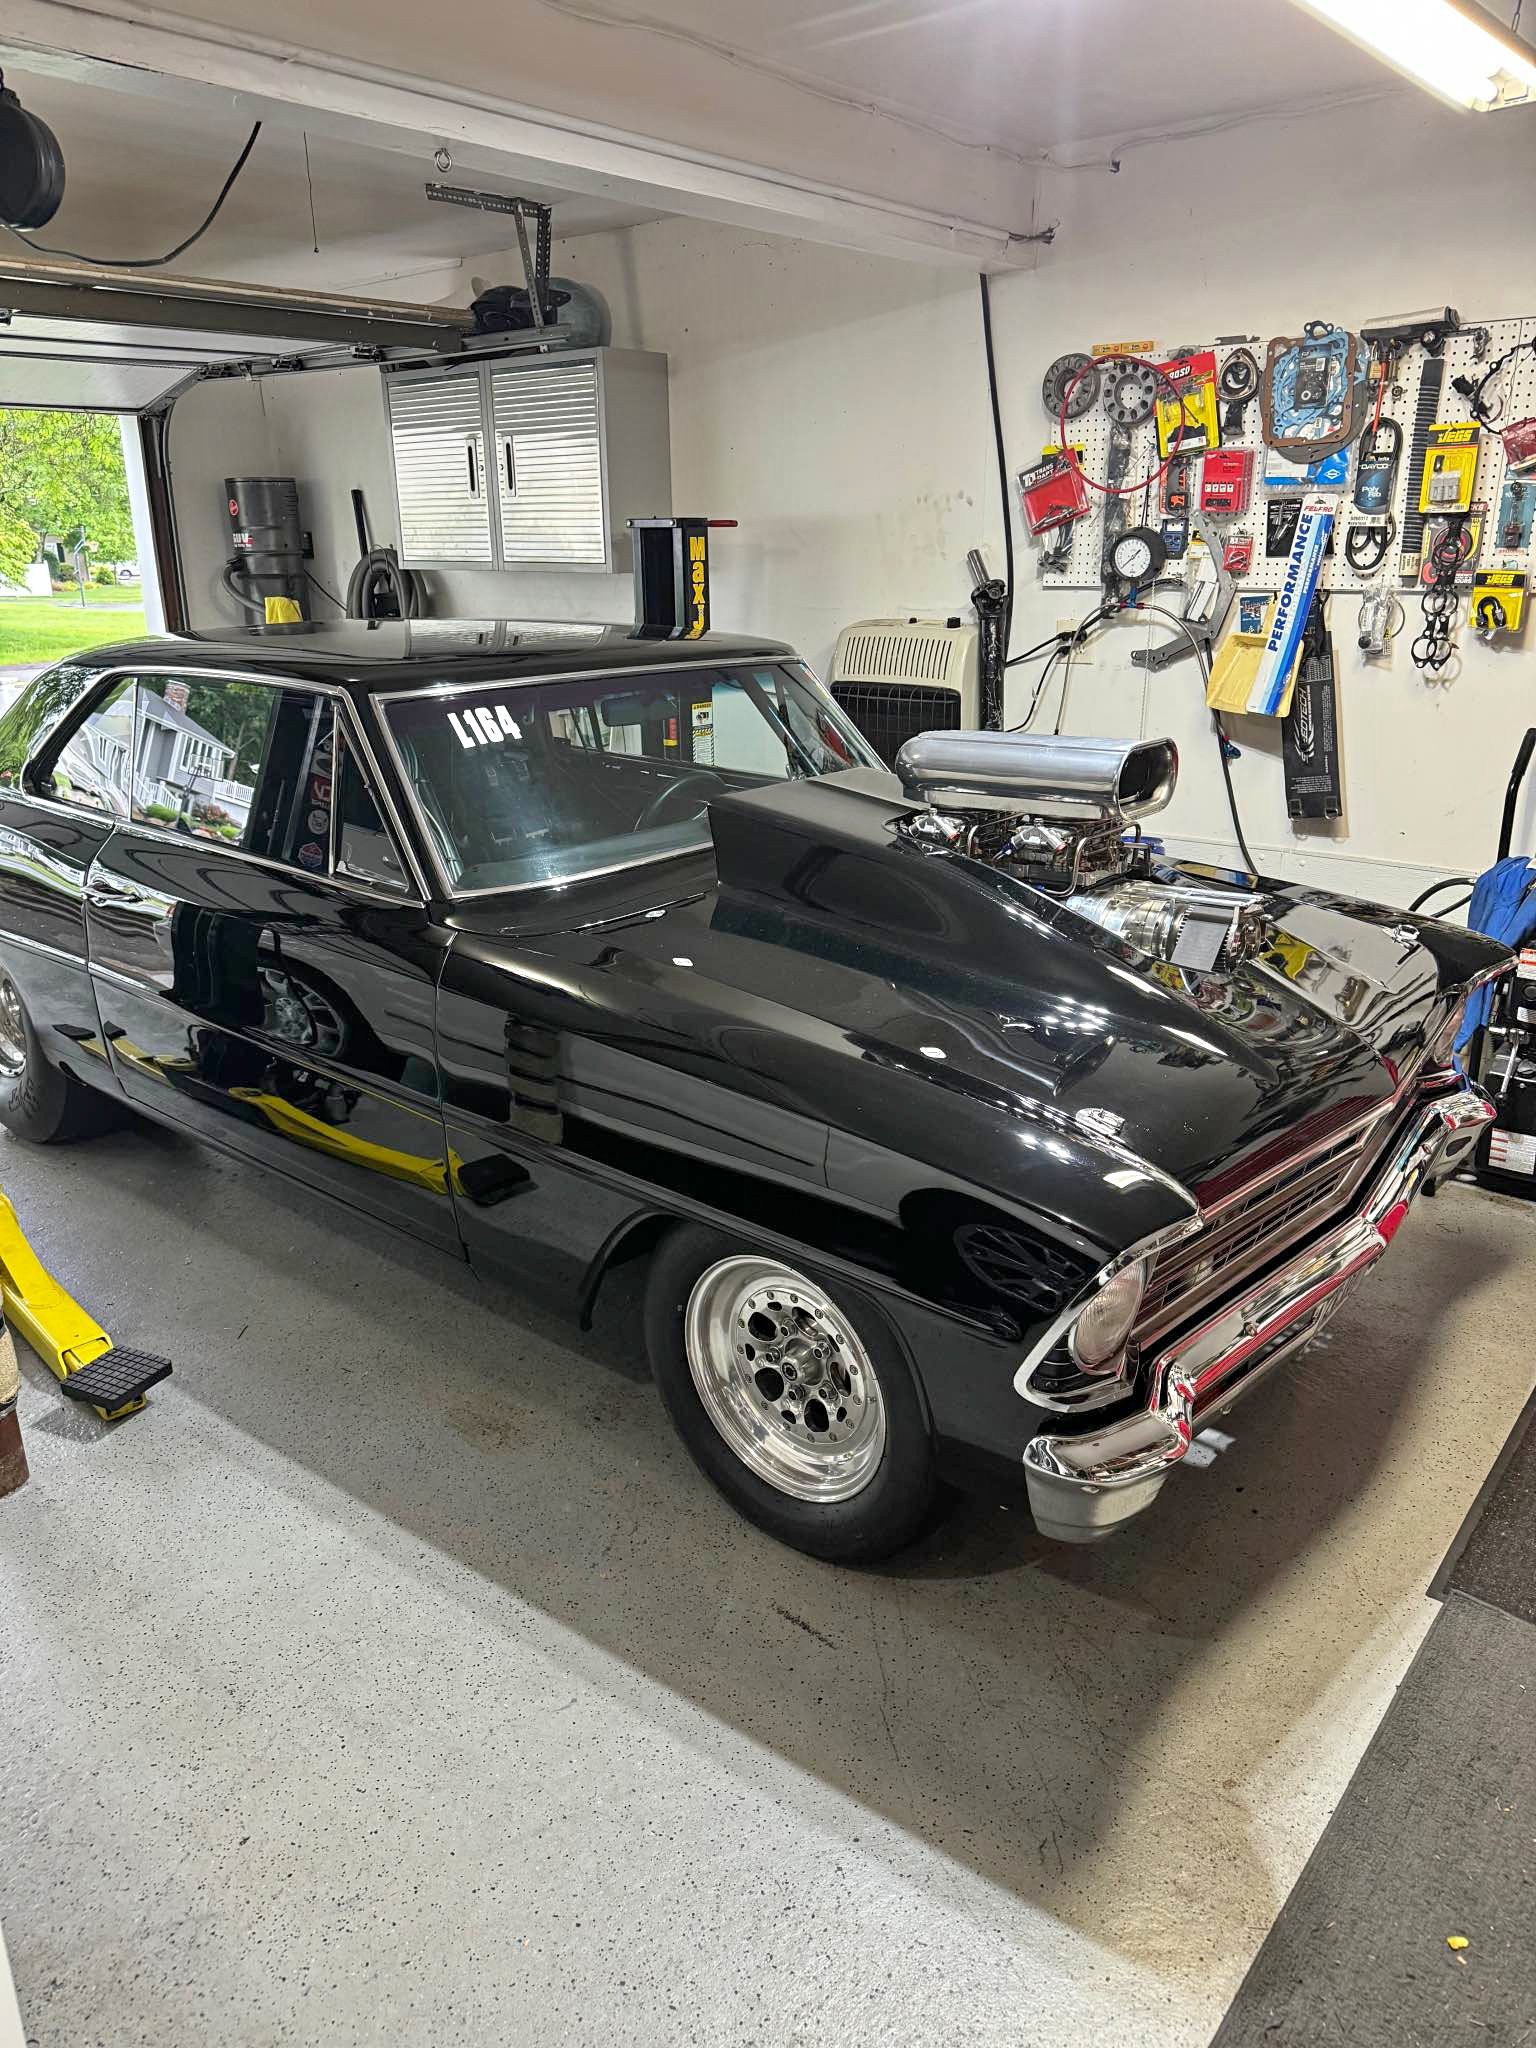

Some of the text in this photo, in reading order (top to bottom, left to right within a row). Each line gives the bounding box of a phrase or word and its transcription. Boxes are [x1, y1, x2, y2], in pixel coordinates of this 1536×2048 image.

[1437, 429, 1473, 443] JEGS
[1361, 485, 1380, 494] Poly
[1267, 513, 1313, 651] PERFORMANCE
[1302, 544, 1319, 594] PERFORMANCE
[1485, 574, 1515, 585] JEGS
[447, 705, 523, 749] L164
